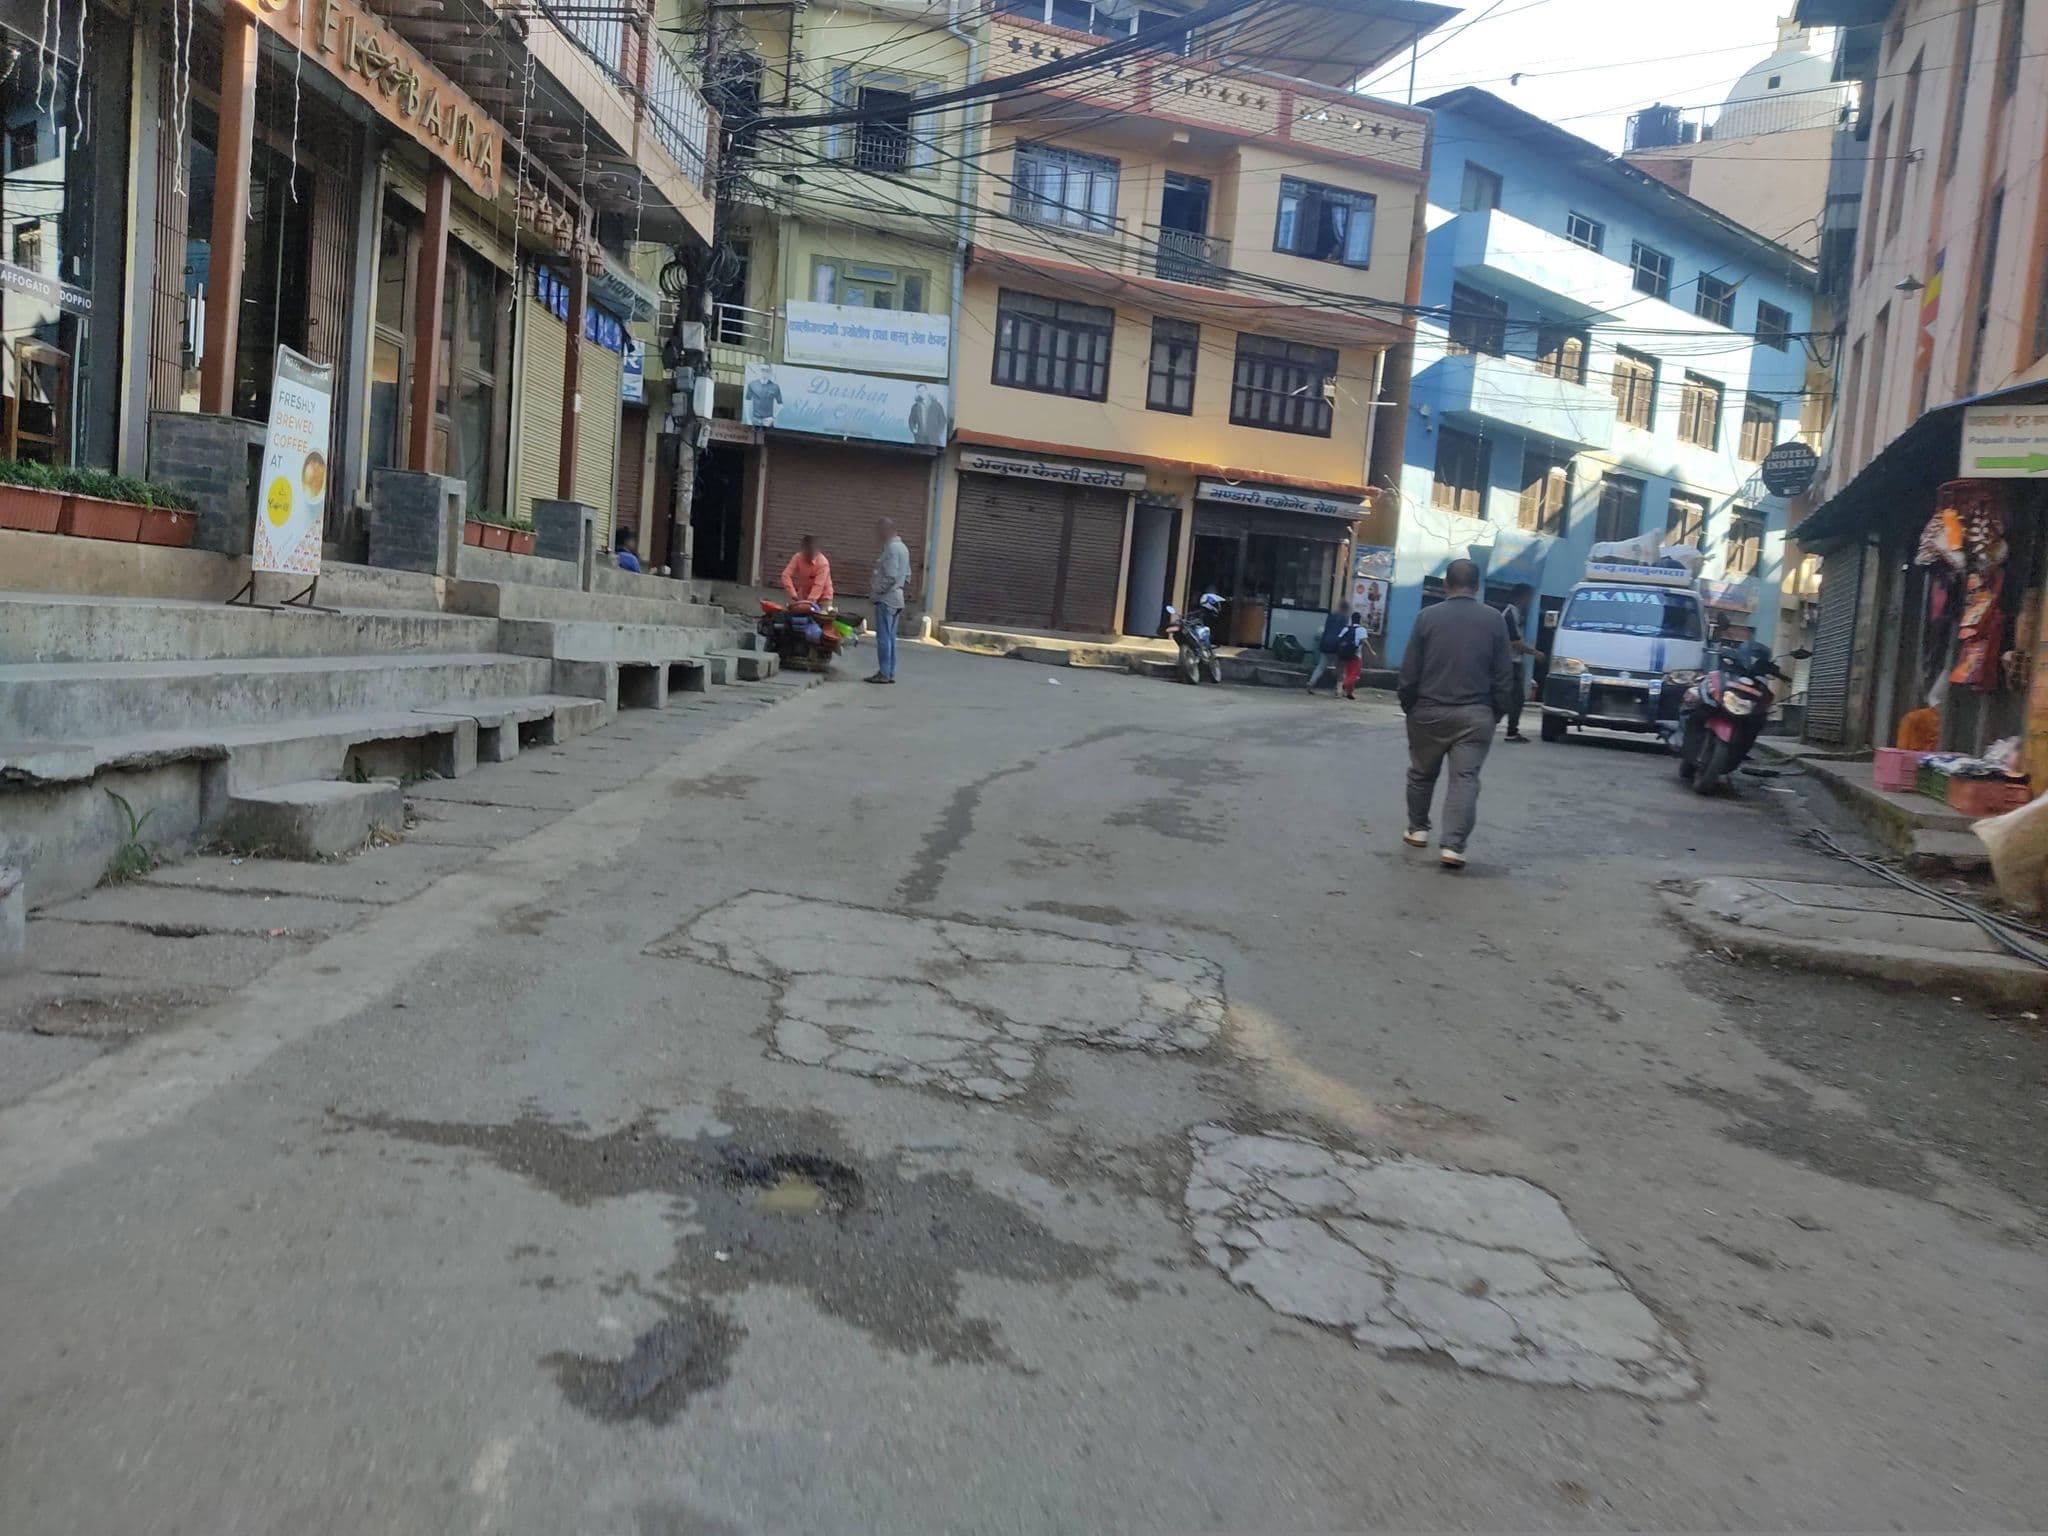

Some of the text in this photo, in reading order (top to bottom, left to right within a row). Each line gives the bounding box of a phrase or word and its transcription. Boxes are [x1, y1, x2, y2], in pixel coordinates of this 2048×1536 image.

[0, 270, 92, 309] AFFOGATO DOPPIO
[808, 375, 889, 404] Darshan
[279, 390, 316, 414] FRESHLY
[276, 411, 313, 434] BREWED
[273, 433, 309, 453] COFFEE
[1771, 450, 1809, 459] HOTEL
[270, 454, 284, 468] AT
